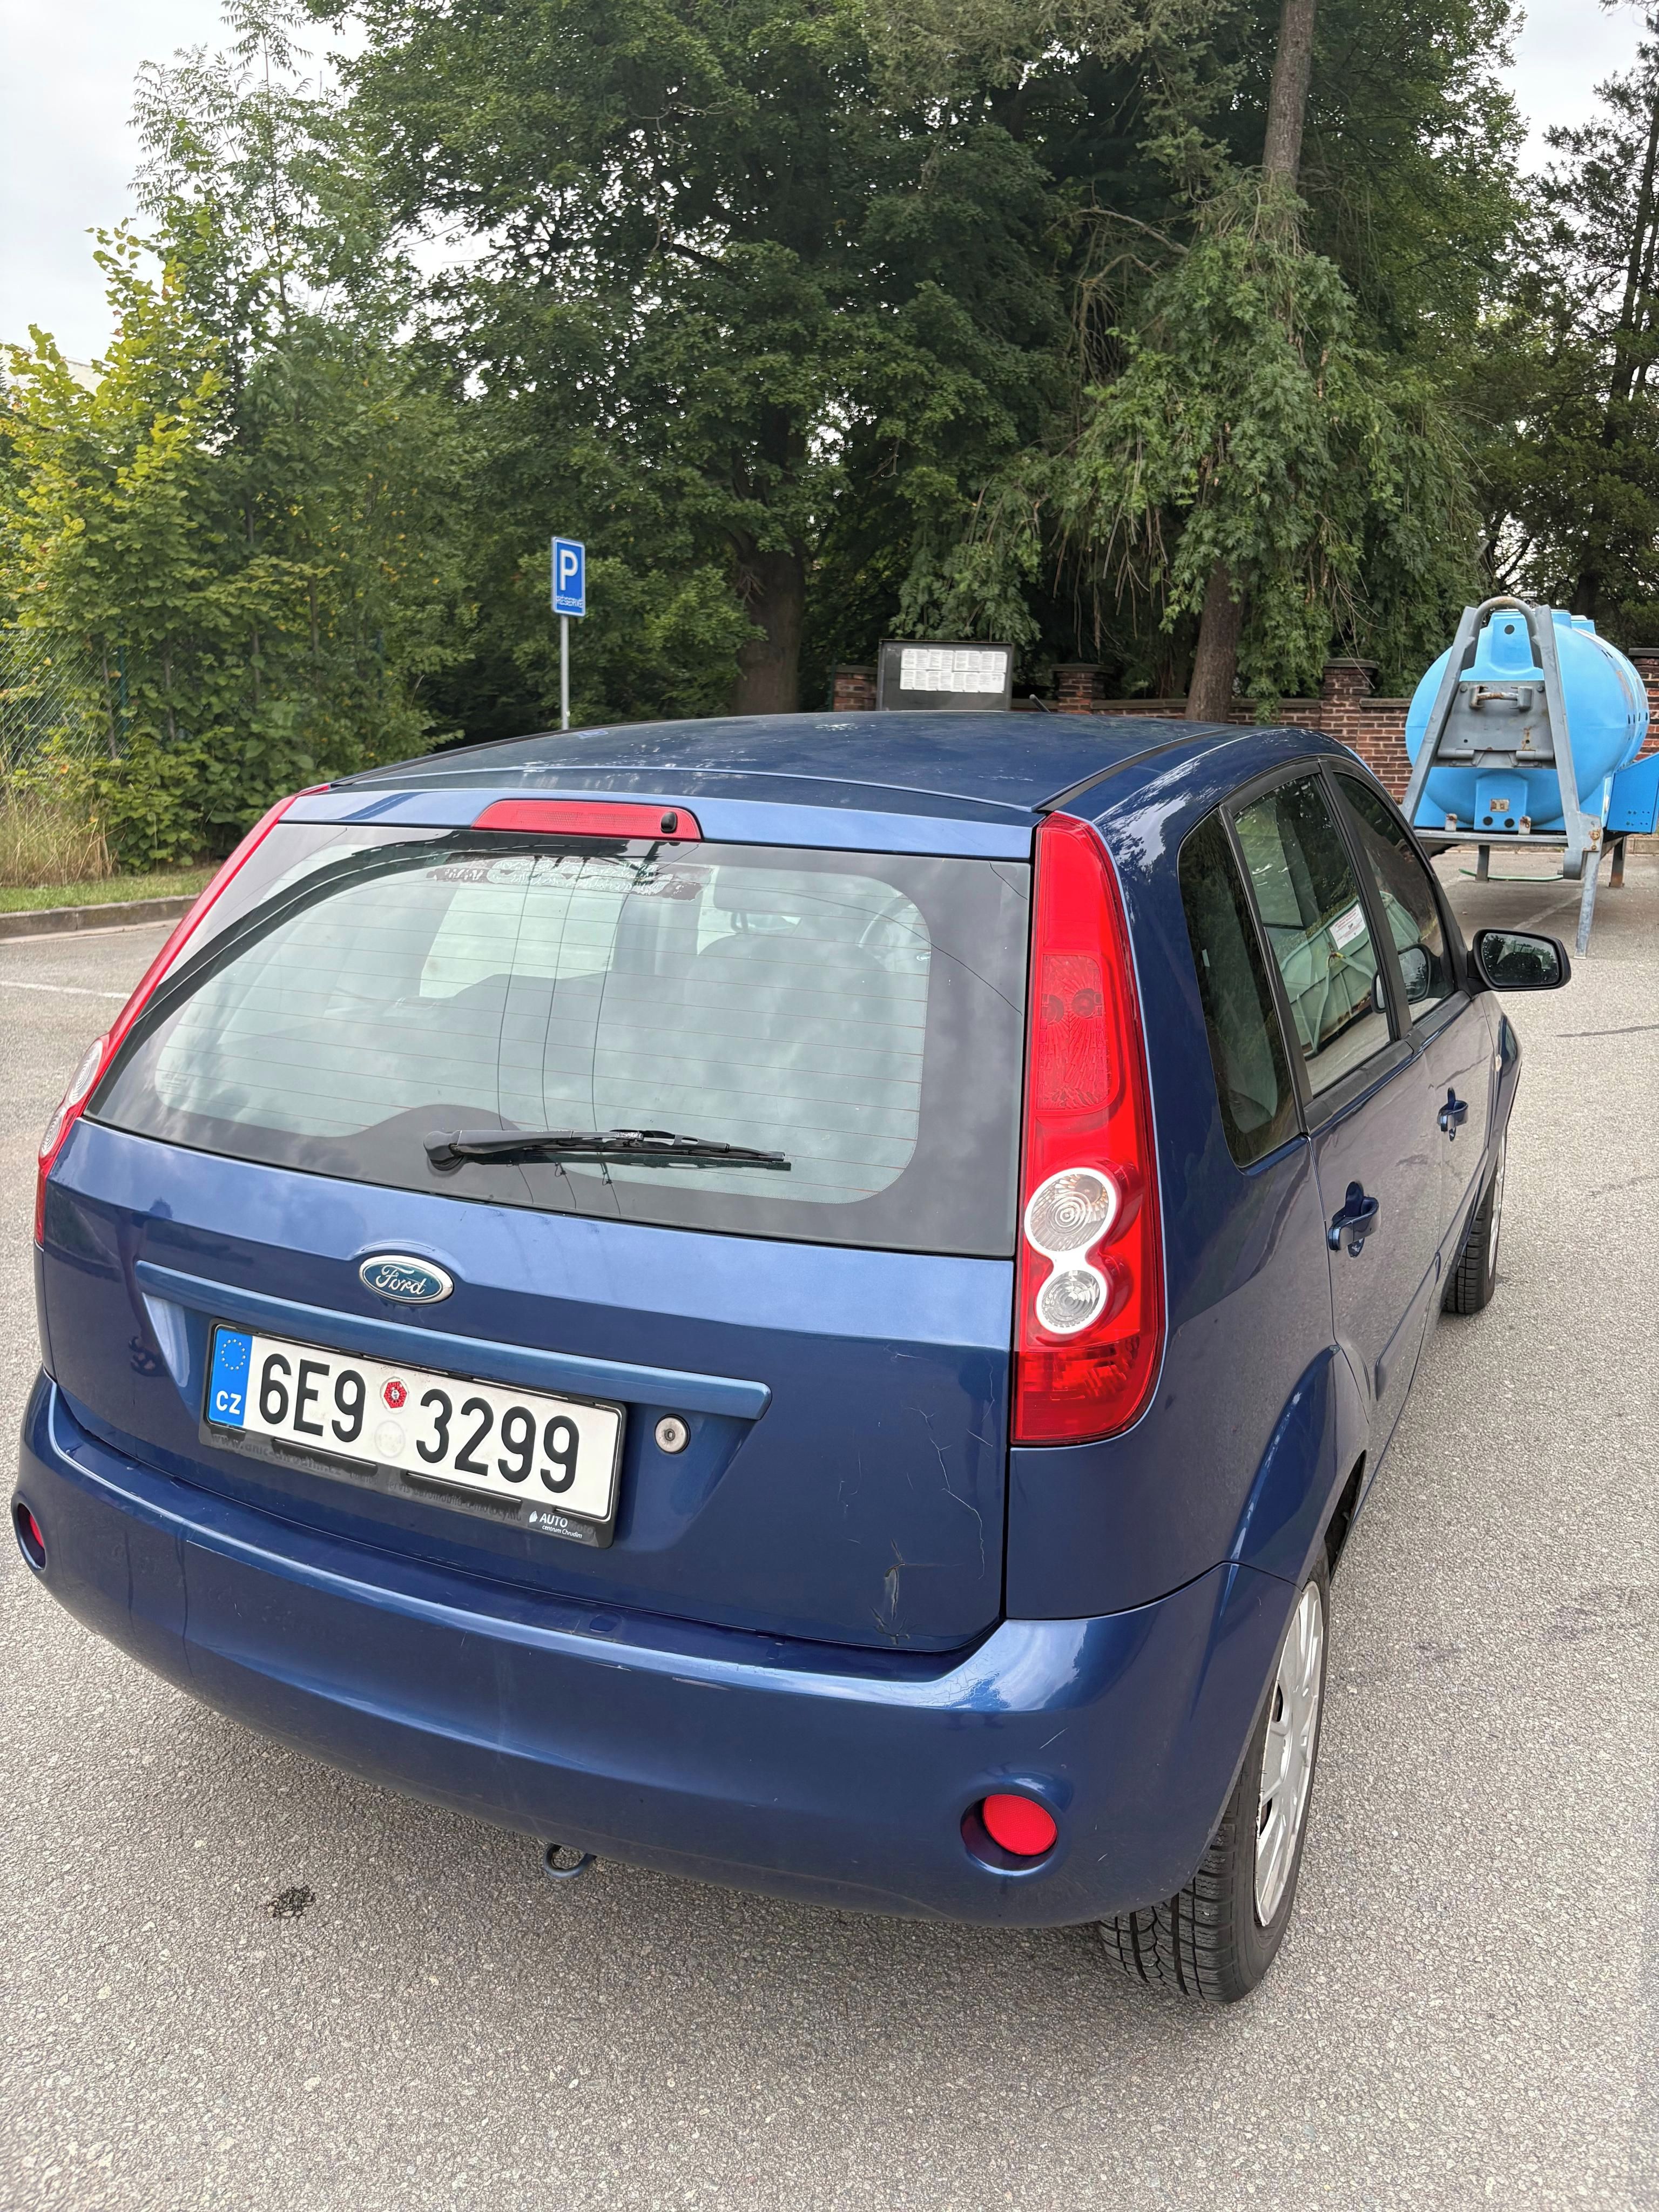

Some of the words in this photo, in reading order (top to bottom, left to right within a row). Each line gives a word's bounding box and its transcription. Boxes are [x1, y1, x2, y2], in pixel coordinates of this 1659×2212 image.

[560, 549, 578, 591] P
[376, 1265, 427, 1295] Ford
[216, 1391, 242, 1415] CZ
[259, 1353, 366, 1442] 6E9
[416, 1389, 578, 1494] 3299
[542, 1525, 561, 1534] centrum
[562, 1529, 583, 1539] Chrudim
